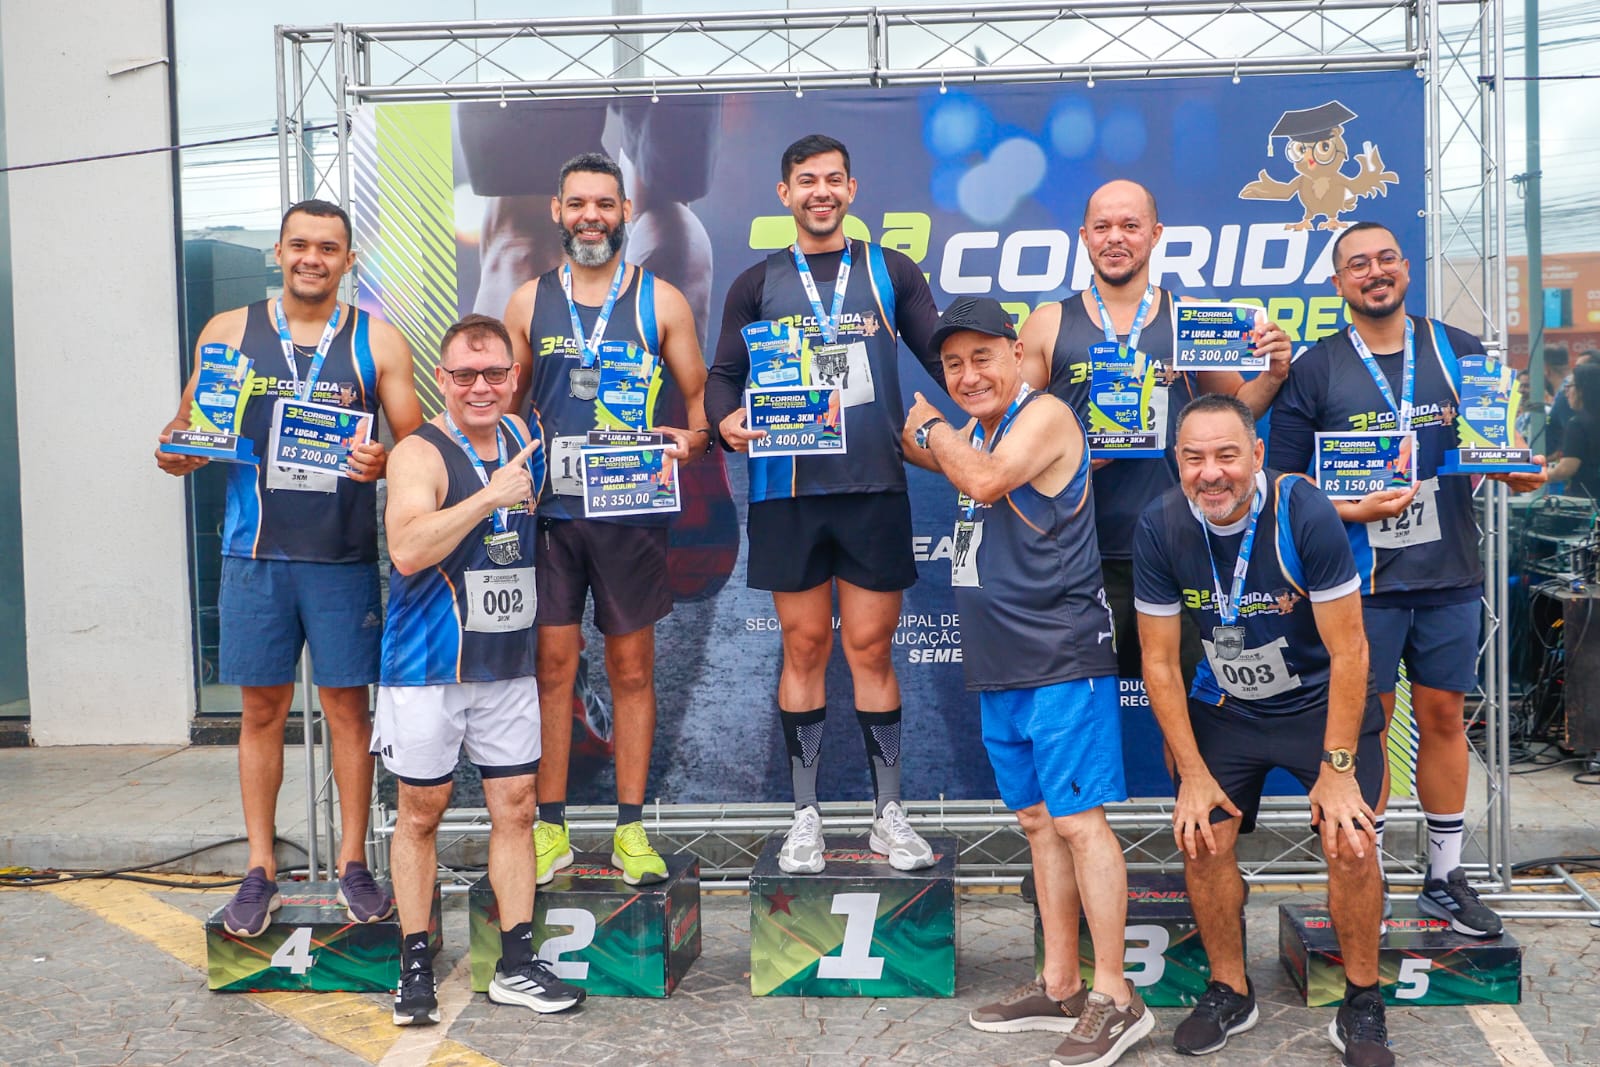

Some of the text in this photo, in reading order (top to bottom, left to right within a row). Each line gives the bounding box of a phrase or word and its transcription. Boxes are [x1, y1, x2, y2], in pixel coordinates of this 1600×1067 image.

[1191, 330, 1216, 339] LUGAR
[1222, 330, 1240, 338] 3KM
[1181, 349, 1239, 362] R$ 300,00
[770, 395, 806, 403] CORRIDA
[303, 410, 336, 422] CORRIDA
[766, 415, 789, 423] LUGAR
[797, 414, 814, 422] 3KM
[189, 434, 209, 442] LUGAR
[294, 427, 318, 439] LUGAR
[324, 433, 340, 443] 3KM
[757, 434, 815, 448] R$ 400,00
[282, 446, 337, 464] R$ 200,00
[604, 455, 640, 463] CORRIDA
[1333, 460, 1359, 468] LUGAR
[1366, 460, 1384, 468] 3KM
[600, 474, 624, 483] LUGAR
[631, 473, 648, 482] 3KM
[603, 483, 636, 491] MASCULINO
[1325, 479, 1384, 492] R$ 150,00
[592, 493, 650, 508] R$ 350,00
[483, 588, 523, 615] 002
[941, 614, 960, 627] DE
[1222, 663, 1275, 686] 003
[817, 893, 884, 980] 1
[270, 927, 313, 974] 4
[538, 908, 596, 980] 2
[1123, 924, 1170, 987] 3
[1395, 958, 1432, 999] 5
